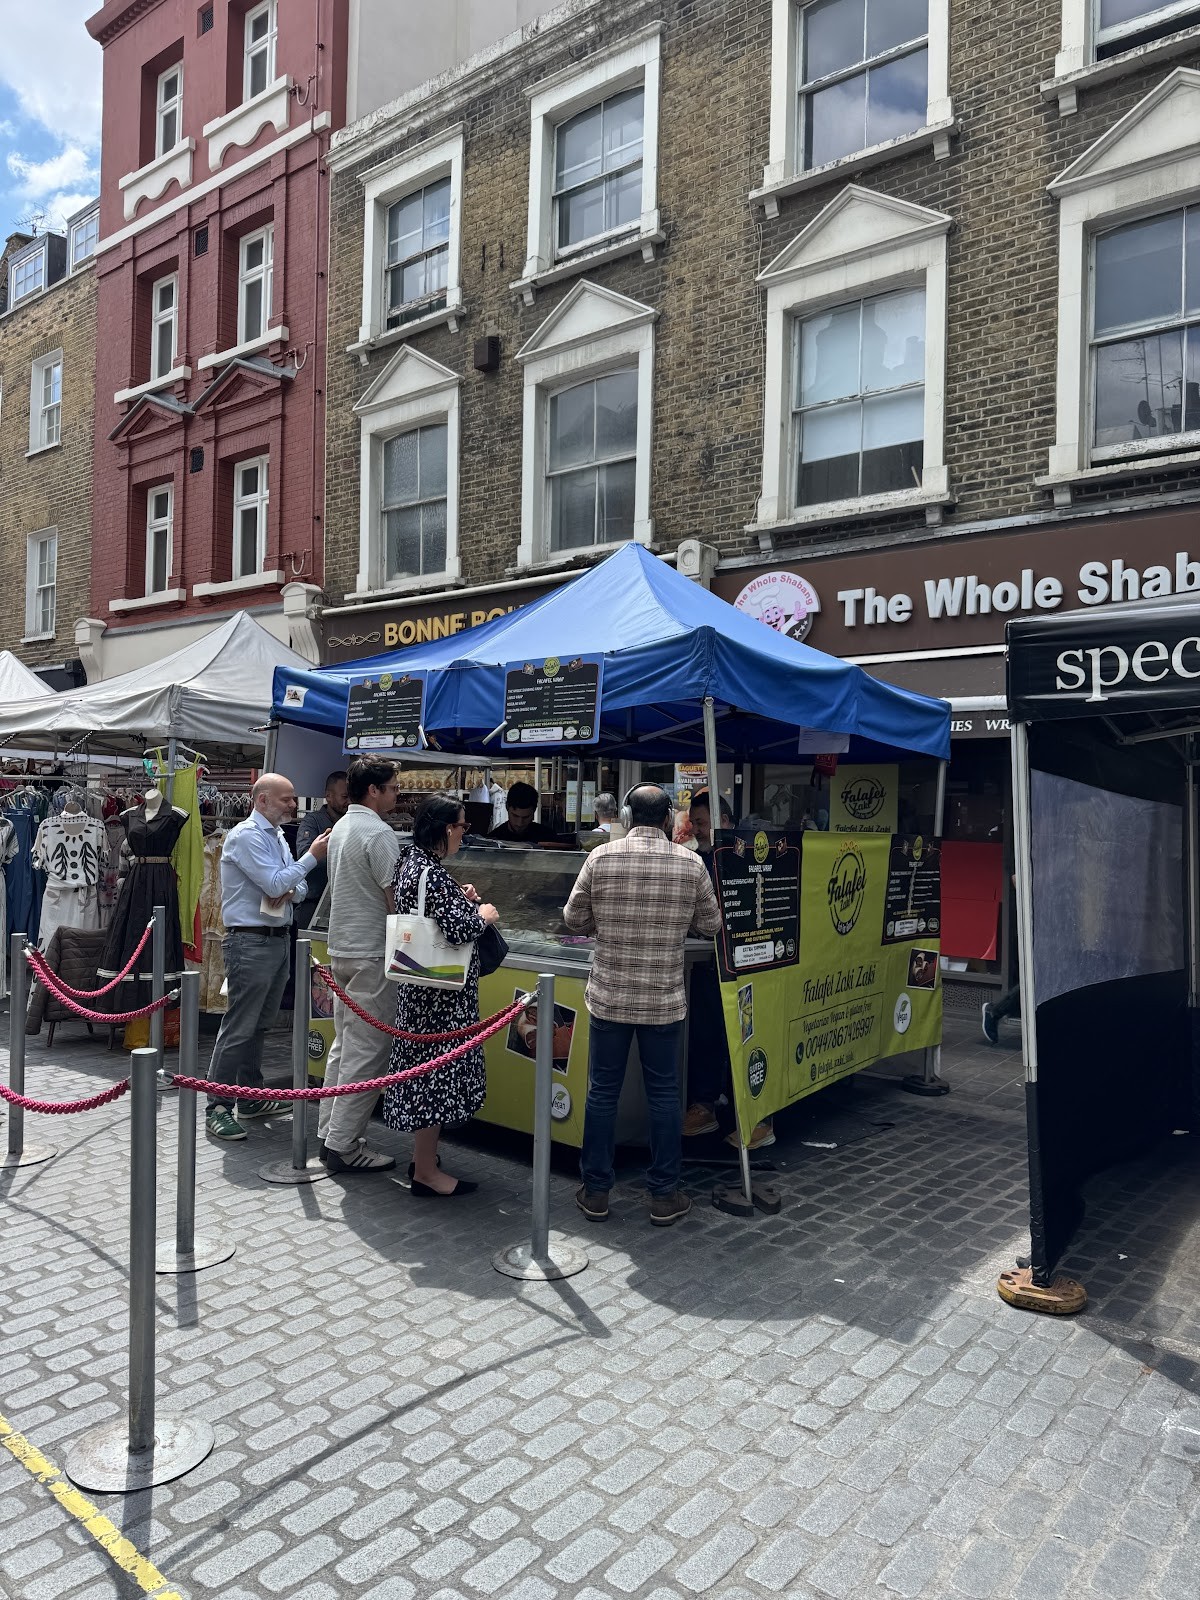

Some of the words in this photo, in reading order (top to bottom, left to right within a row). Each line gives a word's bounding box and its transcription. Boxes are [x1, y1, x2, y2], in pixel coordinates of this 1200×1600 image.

[747, 576, 778, 594] Whole
[779, 574, 814, 606] Shabang
[837, 587, 914, 627] The
[924, 568, 1064, 619] Whole
[1077, 551, 1200, 606] Shab
[384, 612, 466, 647] BONNE
[1056, 636, 1200, 703] spec
[677, 790, 692, 803] 12
[841, 786, 887, 804] Falafel
[828, 867, 867, 906] Falafel
[803, 974, 835, 1006] Falafel
[835, 968, 855, 995] Zaki
[855, 964, 876, 988] Zaki
[308, 1042, 323, 1053] FREE
